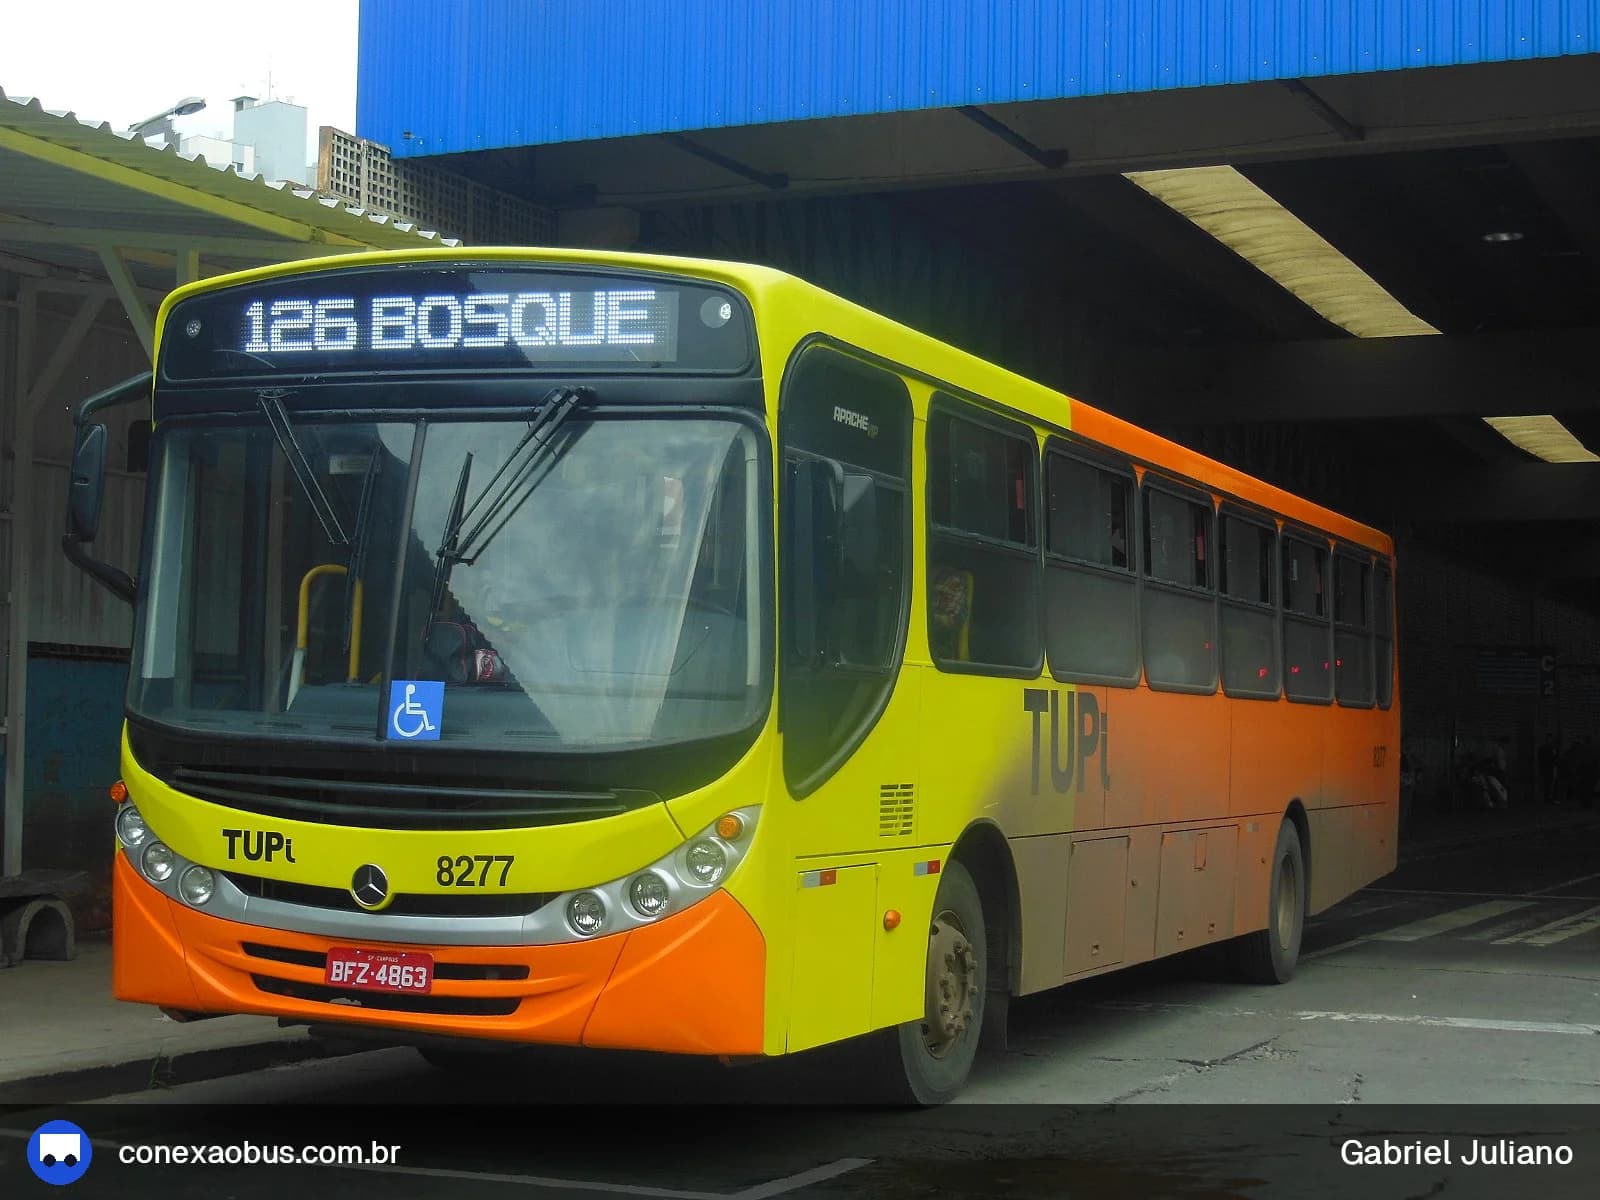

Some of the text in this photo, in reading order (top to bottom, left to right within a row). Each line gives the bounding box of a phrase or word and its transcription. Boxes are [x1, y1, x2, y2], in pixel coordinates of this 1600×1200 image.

[243, 290, 656, 353] 126 BOSQUE
[833, 406, 869, 431] APACHE
[437, 855, 515, 887] 8277
